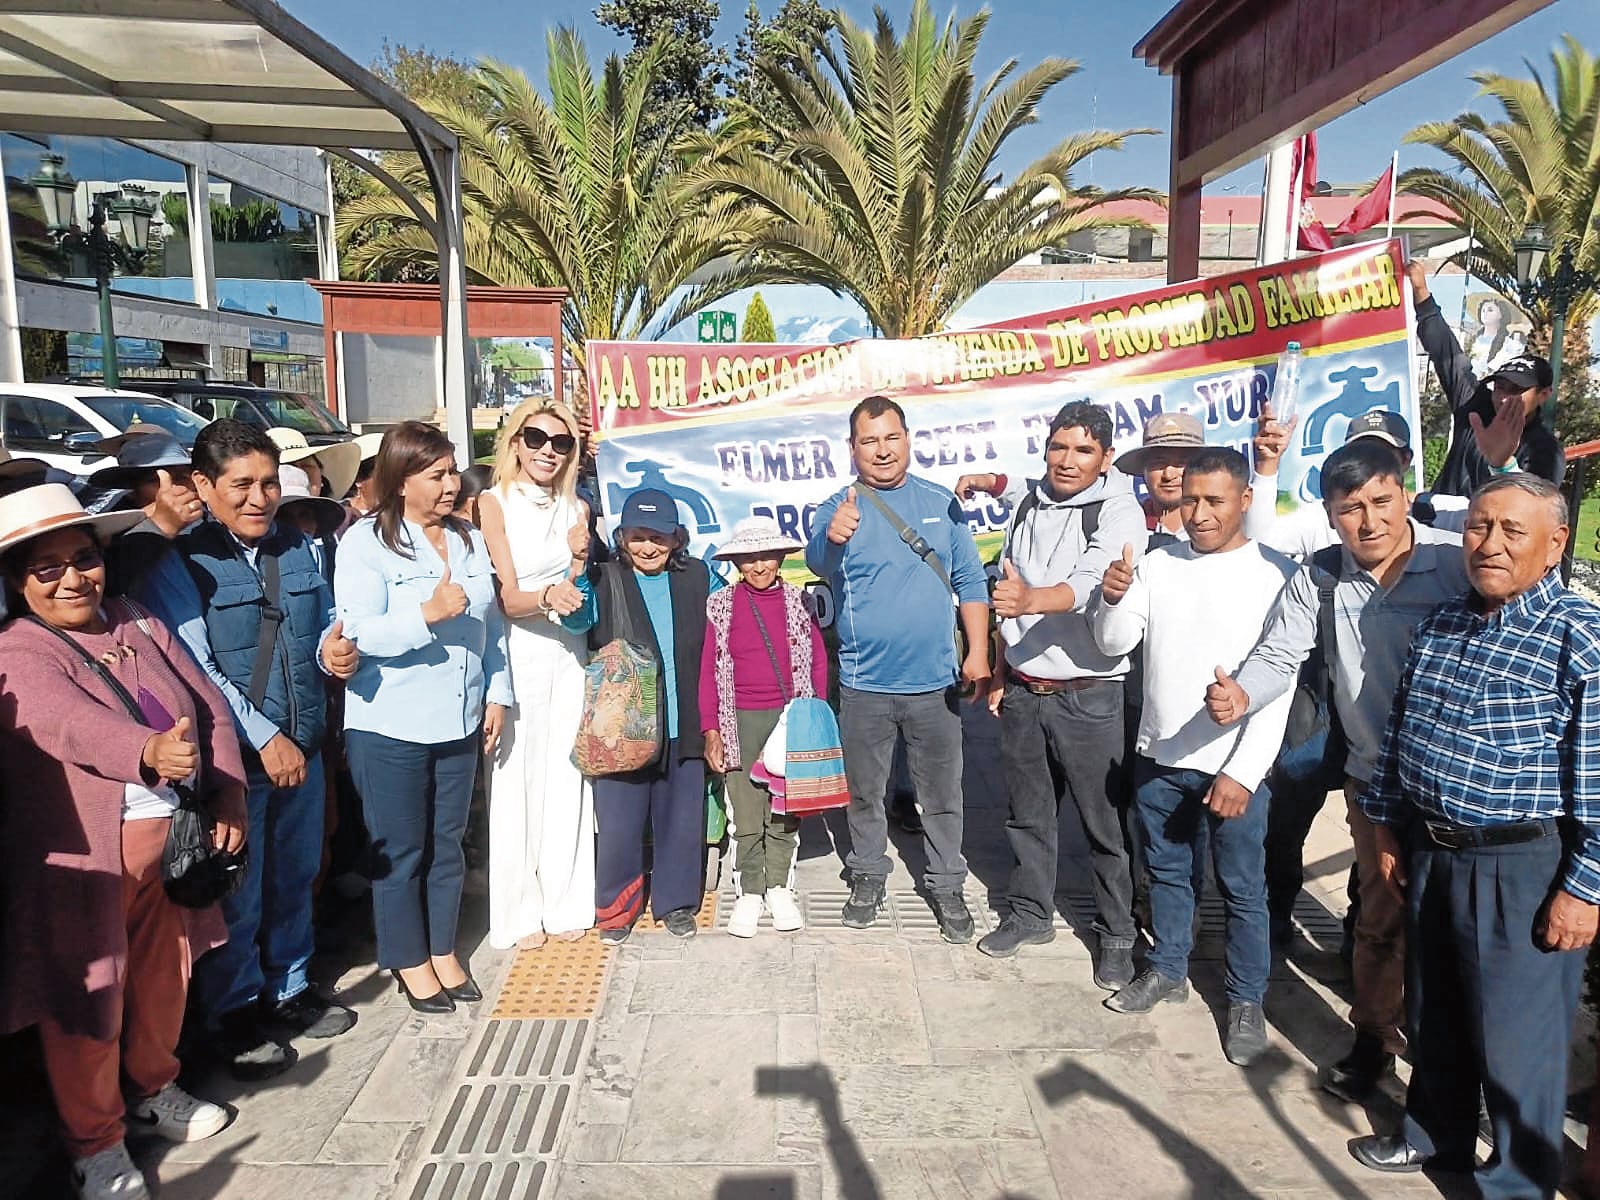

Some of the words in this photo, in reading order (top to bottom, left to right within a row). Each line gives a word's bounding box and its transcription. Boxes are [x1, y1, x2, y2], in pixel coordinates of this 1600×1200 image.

[646, 355, 688, 408] HH
[697, 343, 864, 405] ASOCIACION
[1047, 316, 1090, 367] DE
[1090, 283, 1255, 361] PROPIEDAD
[1258, 253, 1401, 329] FAMILIAR
[717, 439, 837, 487] ELMER
[1196, 373, 1270, 426] YUR
